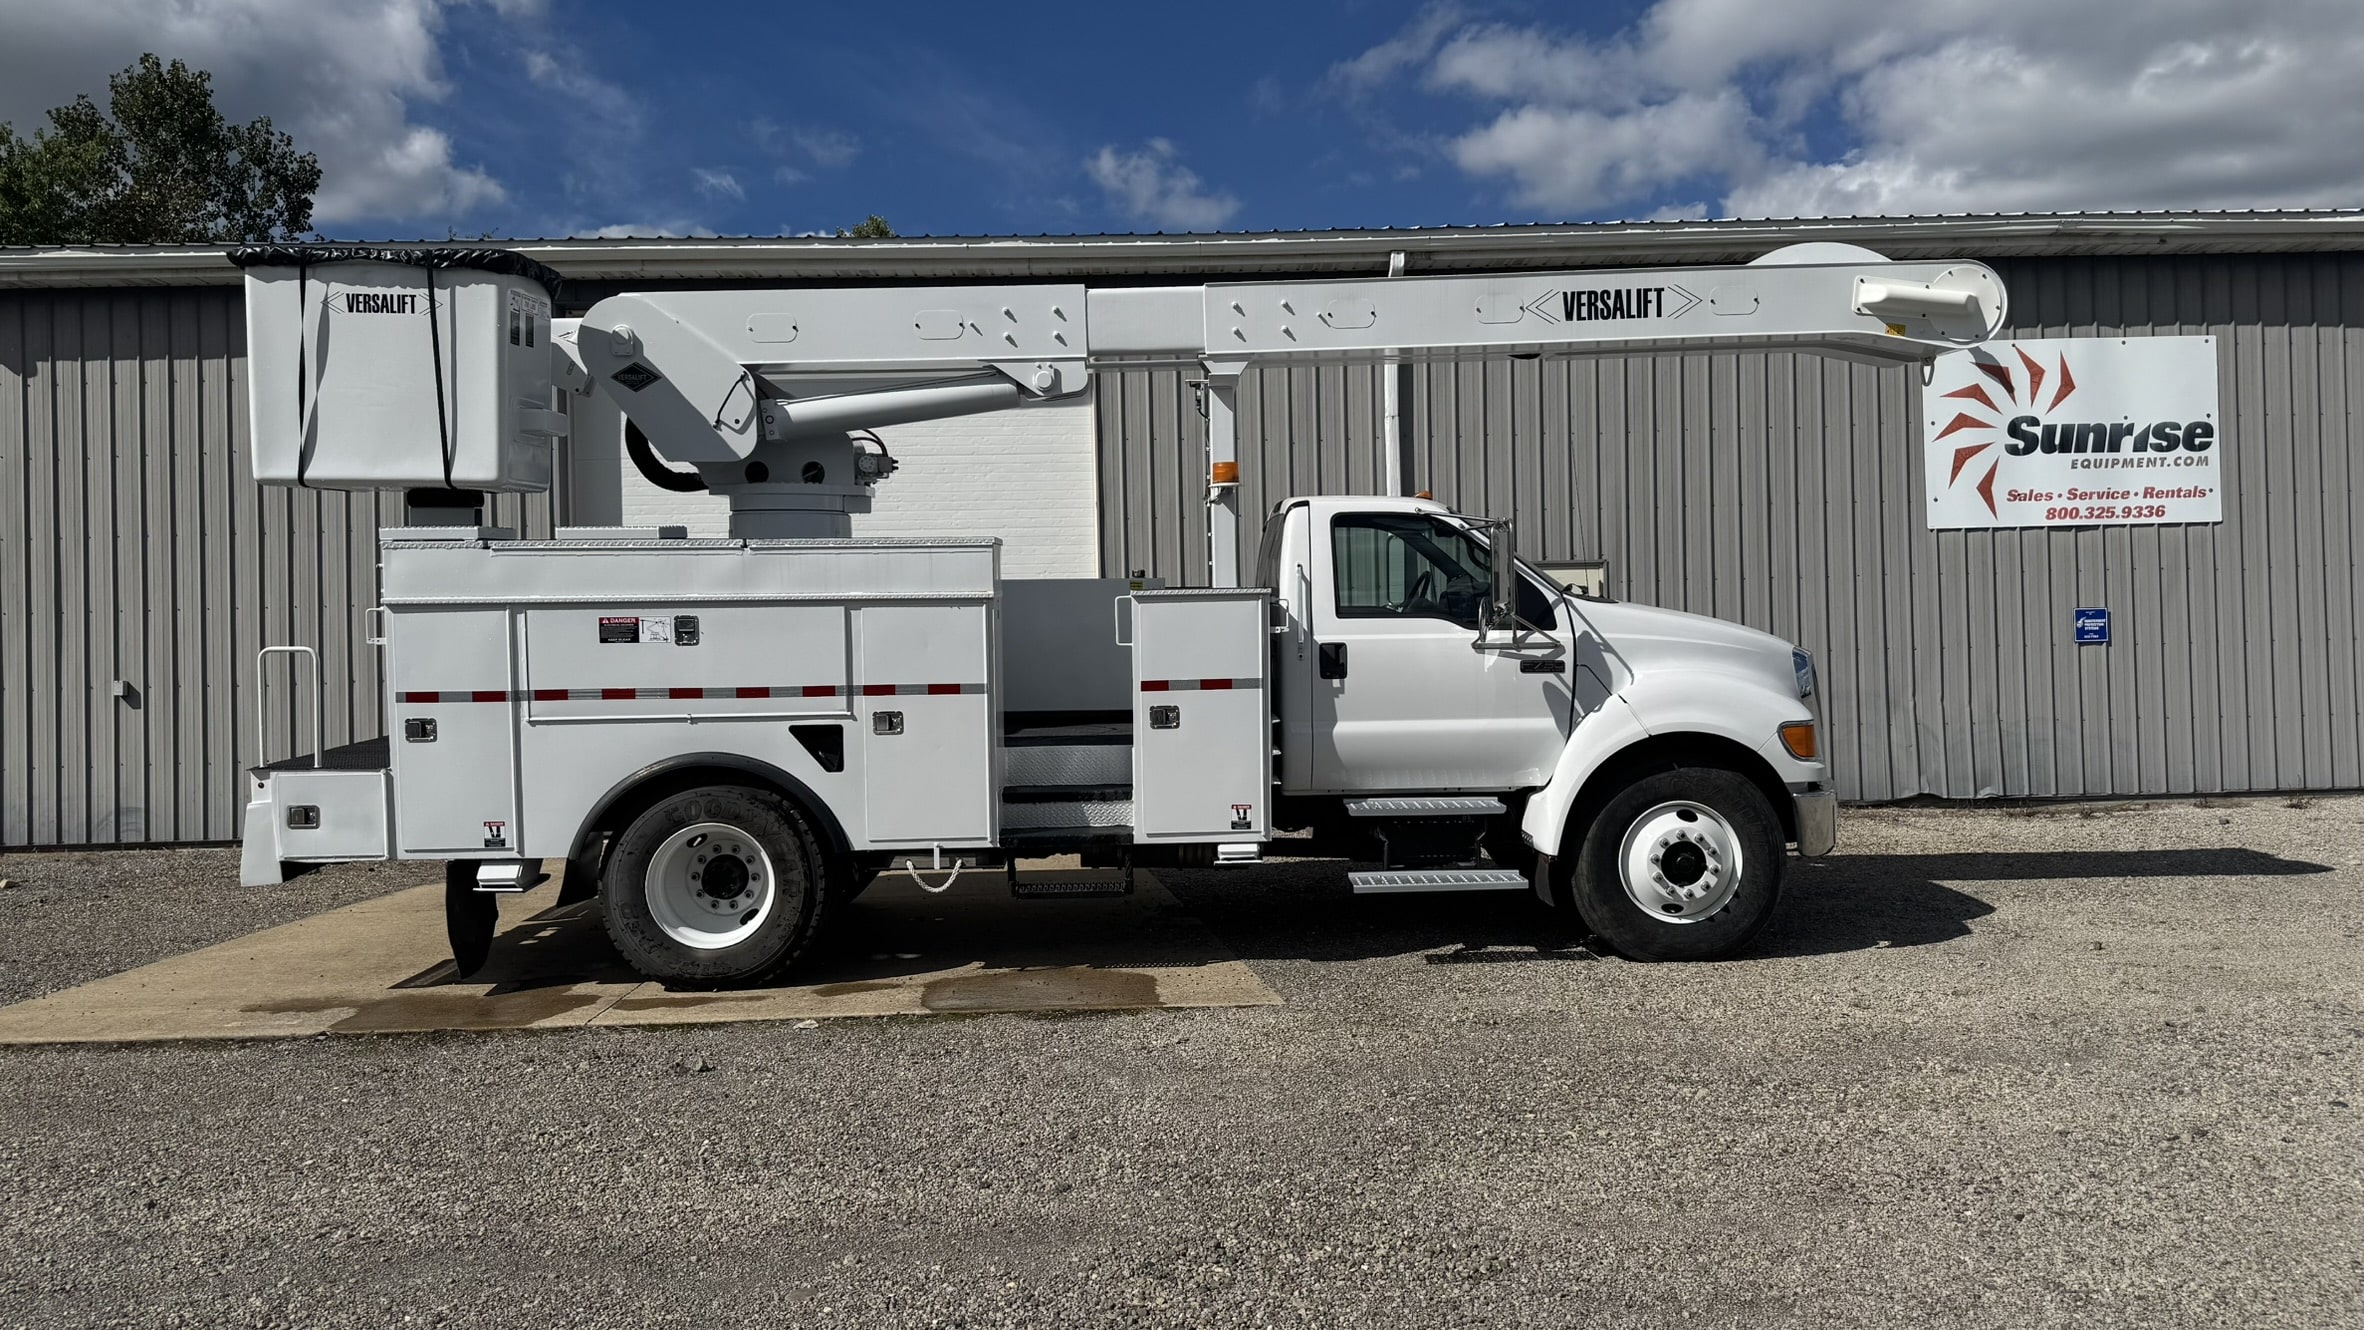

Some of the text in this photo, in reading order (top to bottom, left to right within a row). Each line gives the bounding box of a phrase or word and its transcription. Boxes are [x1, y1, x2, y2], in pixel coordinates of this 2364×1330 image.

[346, 293, 417, 315] VERSALIFT
[1562, 287, 1665, 322] VERSALIFT
[2004, 415, 2214, 457] Sunrise
[2070, 455, 2209, 470] EQUIPMENT.COM
[2006, 485, 2207, 503] Sales Service Rentals
[2045, 504, 2166, 521] 800.325.9336
